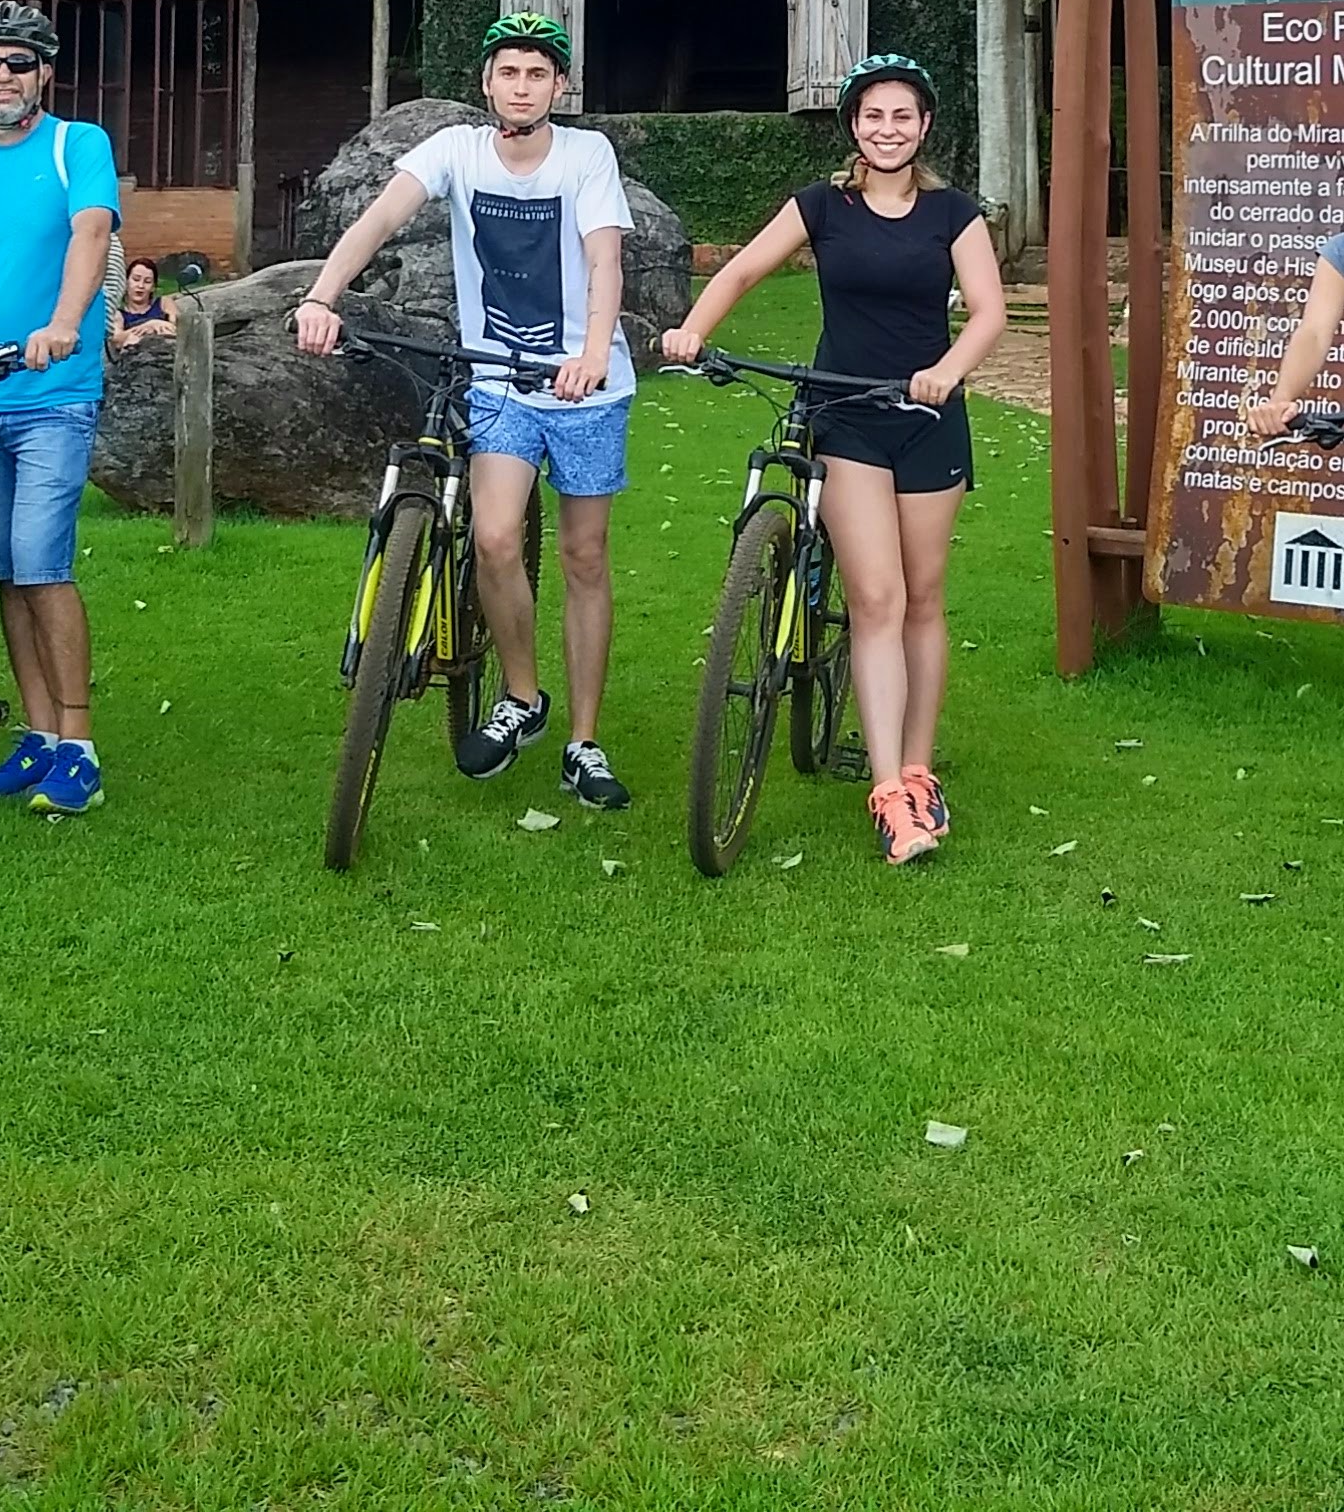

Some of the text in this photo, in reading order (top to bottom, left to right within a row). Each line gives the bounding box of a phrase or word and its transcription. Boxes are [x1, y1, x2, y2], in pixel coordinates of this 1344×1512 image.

[1262, 12, 1323, 43] Eco
[1201, 54, 1322, 86] Cultural
[1189, 123, 1207, 143] A
[1209, 123, 1262, 143] Trilha
[1267, 123, 1292, 143] do
[1246, 152, 1320, 173] permite
[1183, 175, 1313, 197] intensamente
[1317, 181, 1331, 197] a
[1210, 202, 1234, 221] do
[1239, 203, 1314, 223] cerrado
[1319, 204, 1344, 224] da
[1189, 227, 1333, 253] iniciar o passei
[1184, 253, 1316, 277] Museu de His
[1186, 278, 1227, 303] logo
[1232, 281, 1280, 304] após
[1188, 308, 1261, 330] 2.000m
[1185, 335, 1210, 354] de
[1215, 337, 1289, 358] dificuld
[1176, 361, 1249, 384] Mirante
[1254, 369, 1278, 385] no
[1176, 389, 1240, 407] cidade
[1296, 395, 1341, 415] onito
[1184, 443, 1324, 473] contemplação
[1183, 469, 1244, 489] matas
[1249, 477, 1262, 491] e
